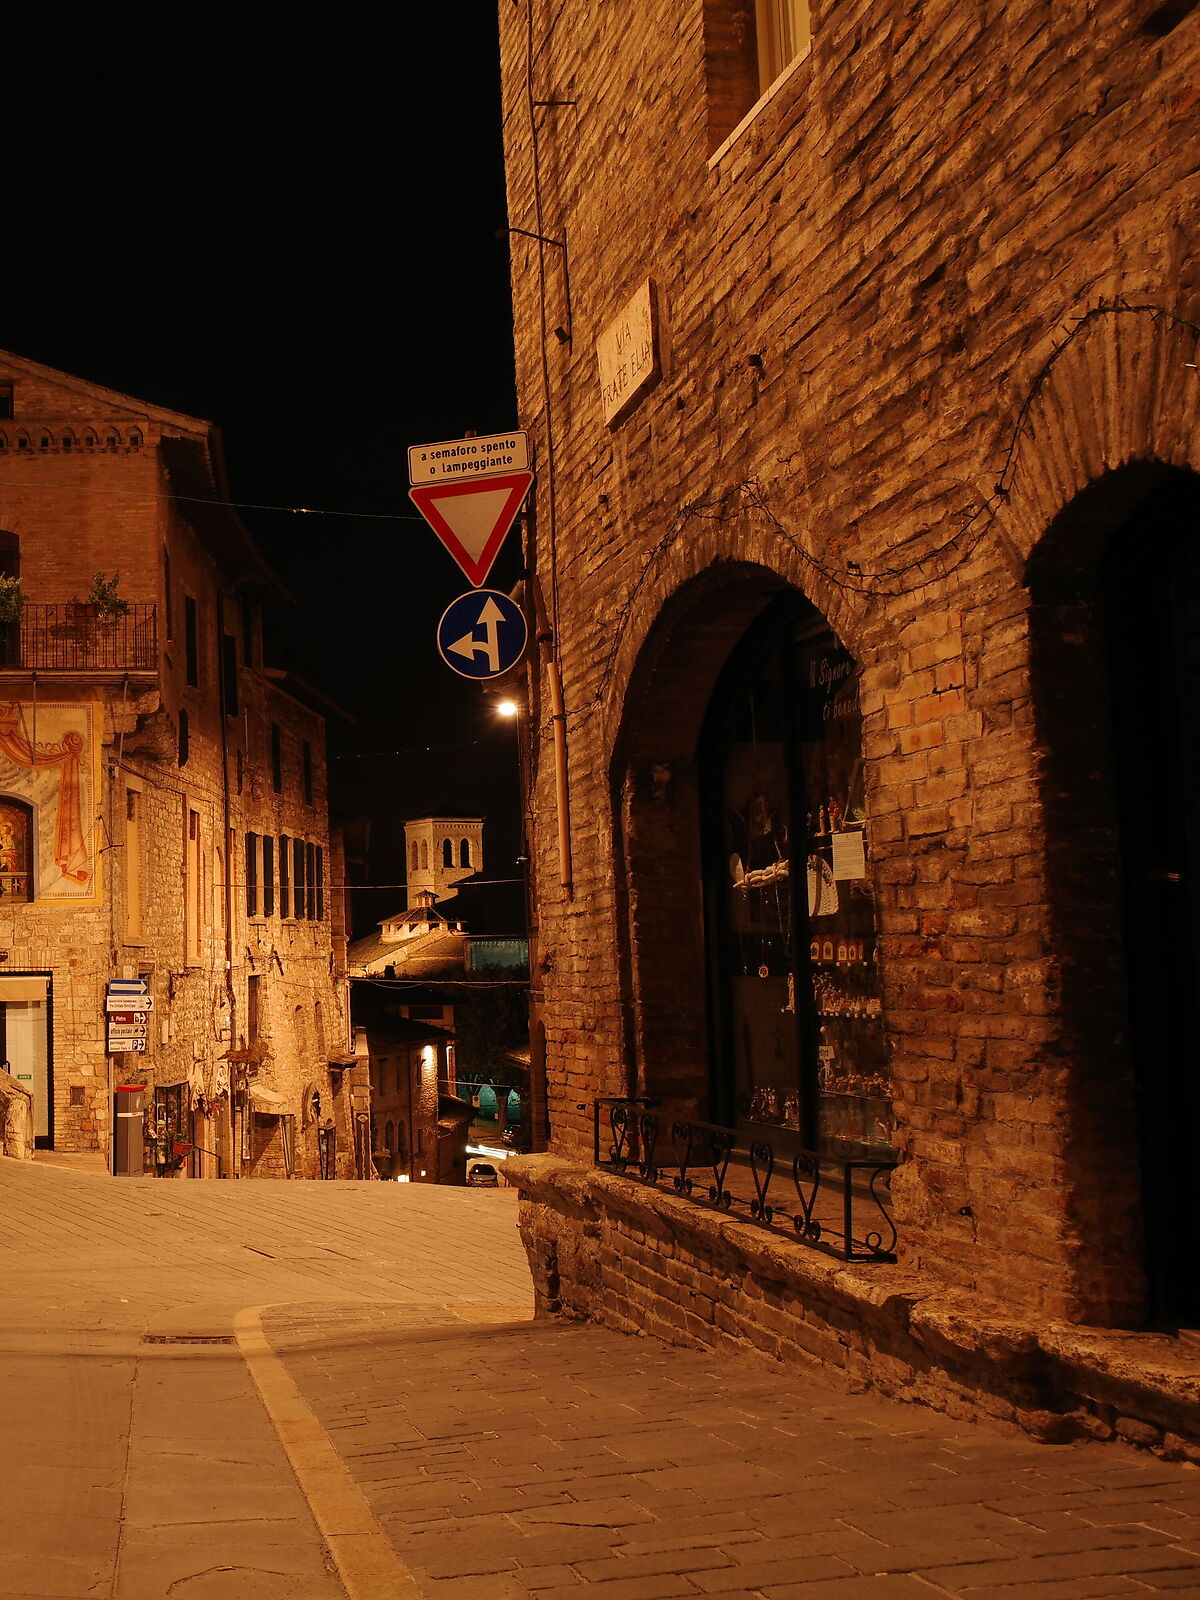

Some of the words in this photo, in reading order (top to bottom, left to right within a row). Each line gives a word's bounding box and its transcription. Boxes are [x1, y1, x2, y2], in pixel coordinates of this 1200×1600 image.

[615, 321, 632, 355] VIA
[602, 362, 629, 411] FRATE
[631, 339, 652, 378] ELIA
[421, 452, 427, 461] a
[430, 445, 477, 460] semaforo
[481, 440, 516, 454] spento
[430, 466, 436, 475] o
[442, 455, 513, 473] lampeggiante
[818, 657, 852, 694] Signore
